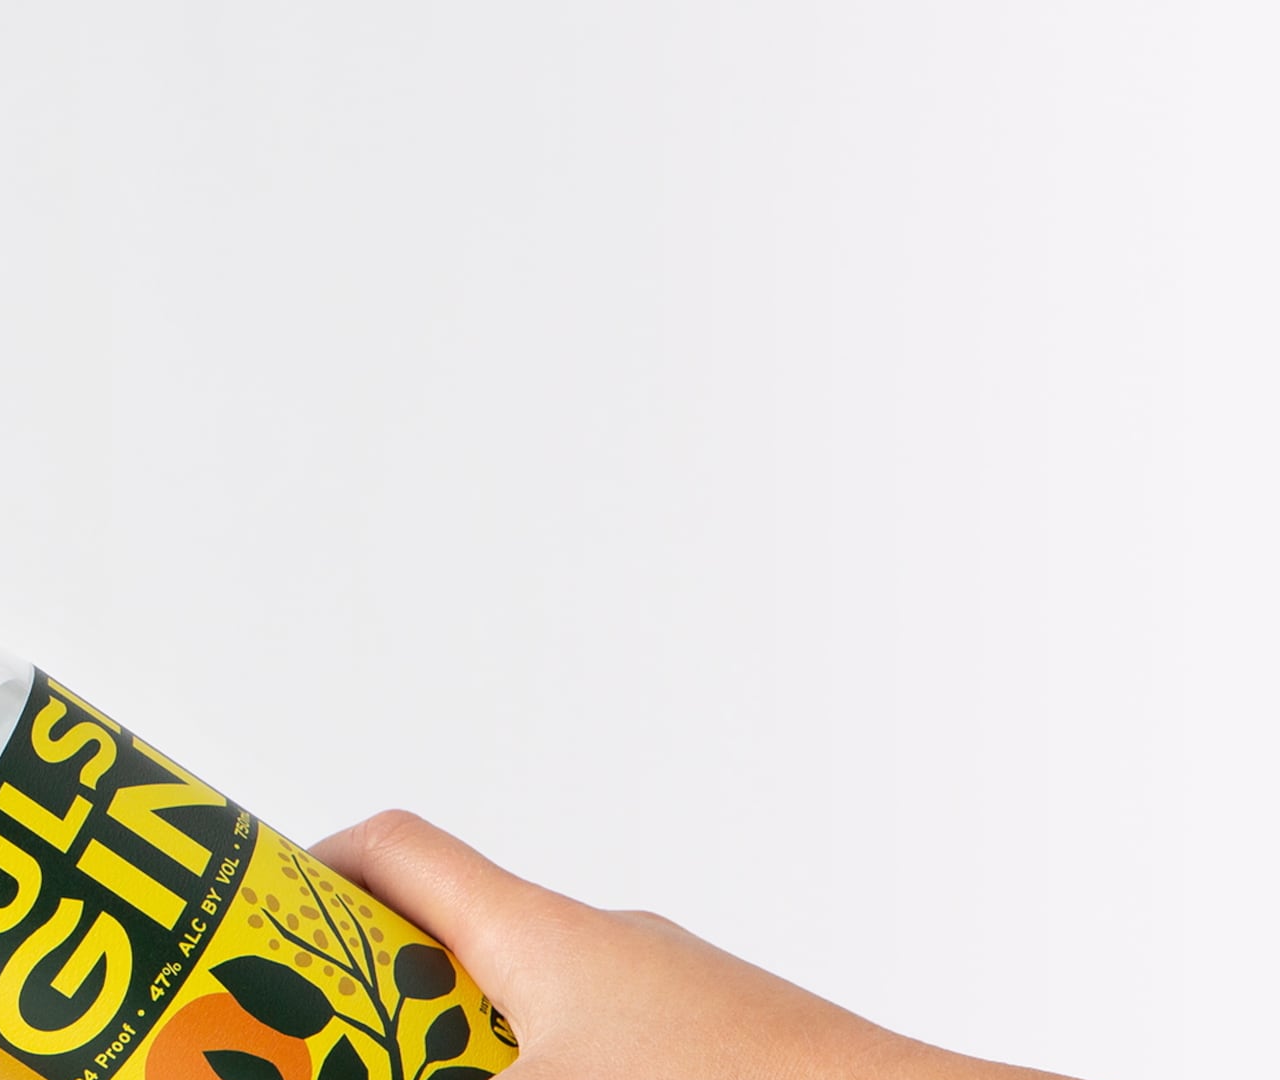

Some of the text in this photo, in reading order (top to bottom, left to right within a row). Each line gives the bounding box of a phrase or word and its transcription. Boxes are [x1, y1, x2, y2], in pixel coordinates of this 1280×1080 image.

[94, 1022, 137, 1069] Proof
[149, 961, 183, 1002] 47%
[178, 917, 208, 957] ALC
[201, 887, 223, 916] BY
[216, 857, 241, 885] VOL
